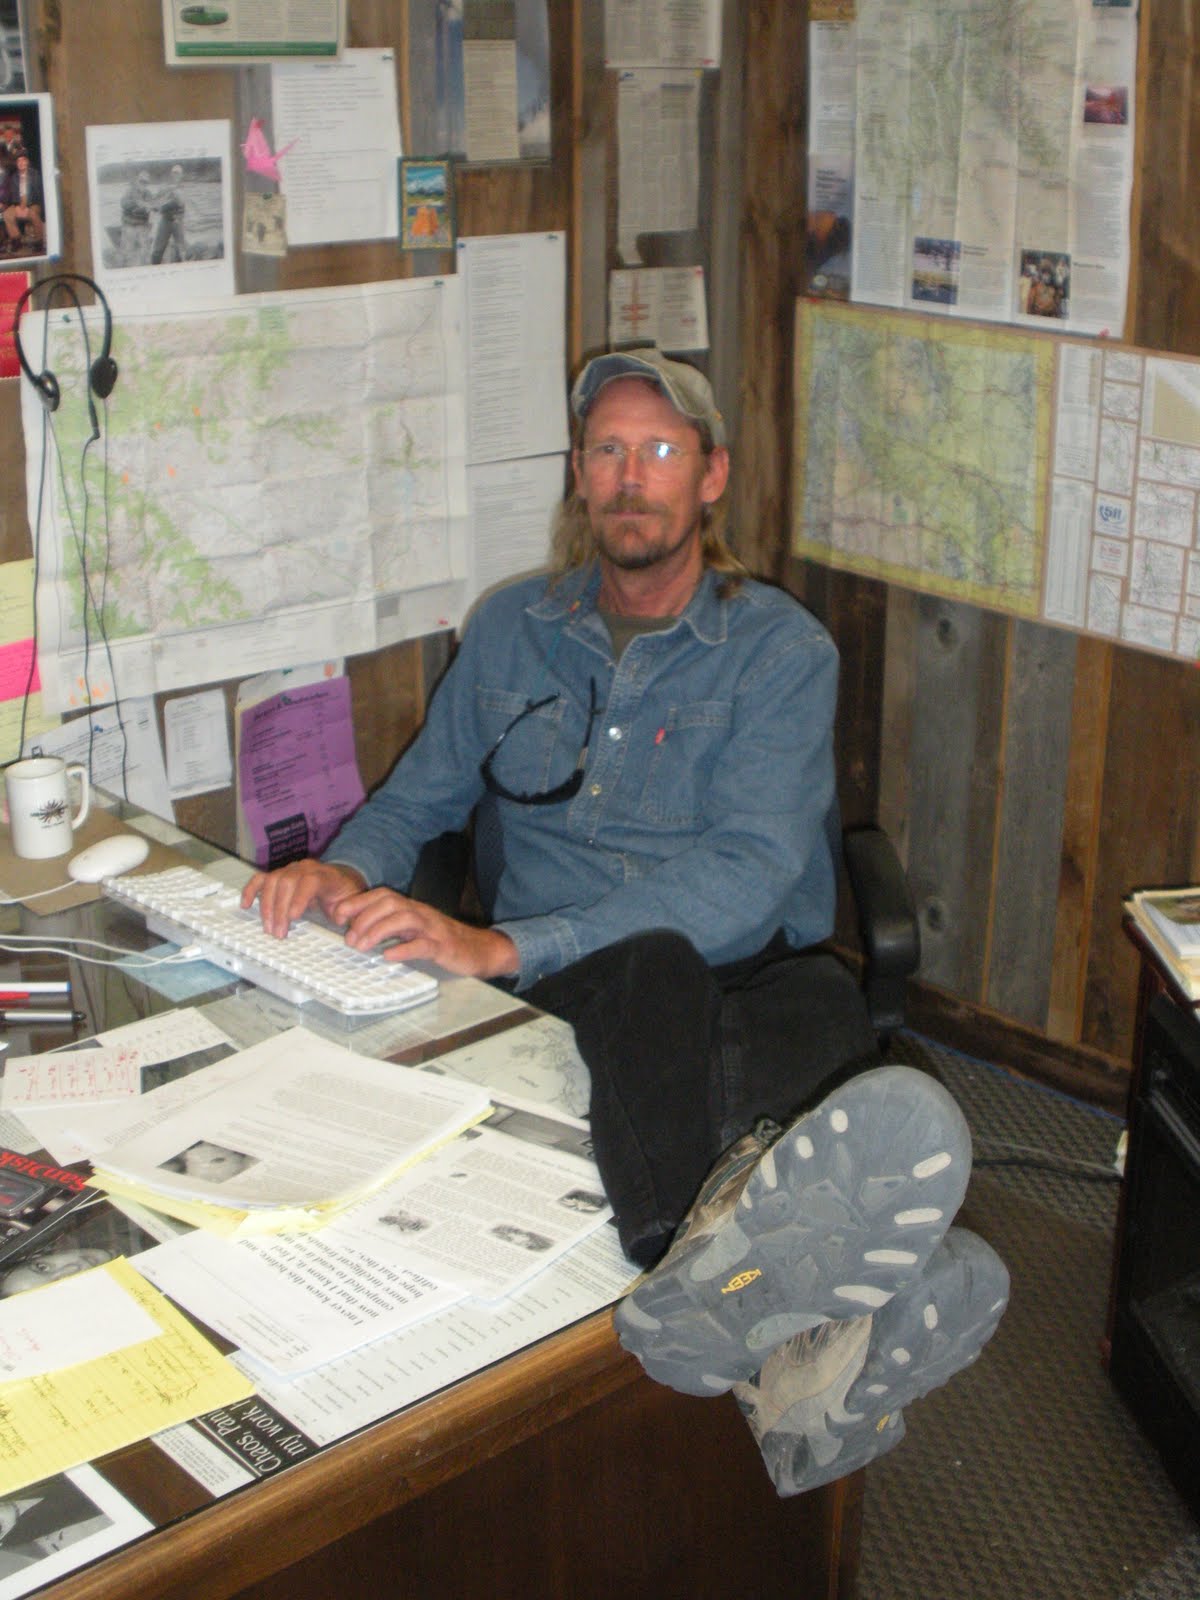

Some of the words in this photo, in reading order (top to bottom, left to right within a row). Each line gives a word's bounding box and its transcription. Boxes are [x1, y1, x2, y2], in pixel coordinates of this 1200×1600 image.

[0, 1151, 86, 1192] SanDisk
[238, 1239, 259, 1252] and
[259, 1250, 288, 1274] before,
[311, 1256, 335, 1271] send
[336, 1255, 384, 1288] intelligent
[288, 1271, 305, 1285] this
[306, 1267, 332, 1287] know
[378, 1266, 400, 1282] that
[721, 1268, 762, 1294] KEEN
[306, 1285, 331, 1304] knew
[336, 1289, 358, 1305] that
[343, 1278, 394, 1311] compelled
[382, 1286, 408, 1304] more
[398, 1280, 423, 1299] hope
[330, 1303, 358, 1321] never
[359, 1304, 380, 1319] now
[200, 1408, 242, 1436] Pani
[241, 1405, 283, 1438] work
[236, 1431, 282, 1473] Chaos,
[276, 1434, 307, 1456] my
